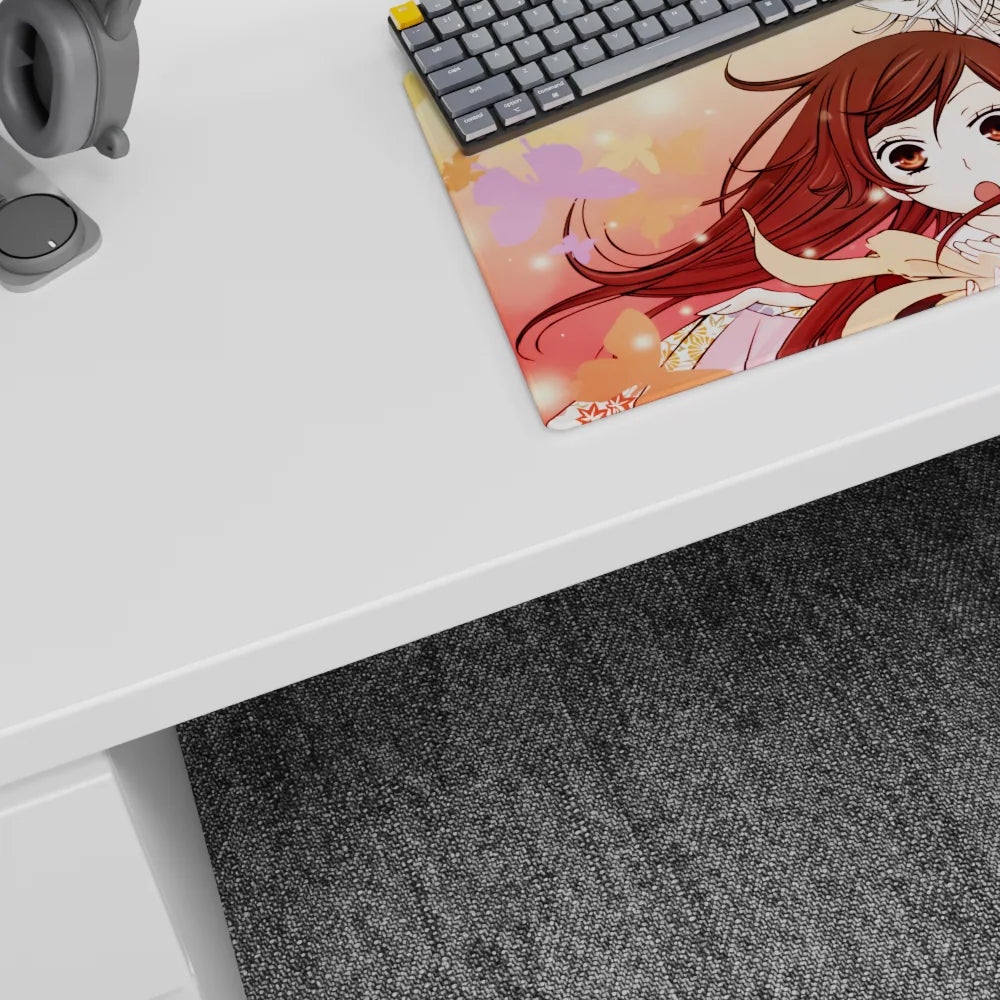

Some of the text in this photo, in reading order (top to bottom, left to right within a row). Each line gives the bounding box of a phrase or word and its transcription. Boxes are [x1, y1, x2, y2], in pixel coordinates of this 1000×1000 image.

[447, 66, 462, 75] caps
[468, 85, 482, 94] shift
[537, 80, 565, 95] command
[503, 98, 522, 109] option
[463, 112, 484, 124] control
